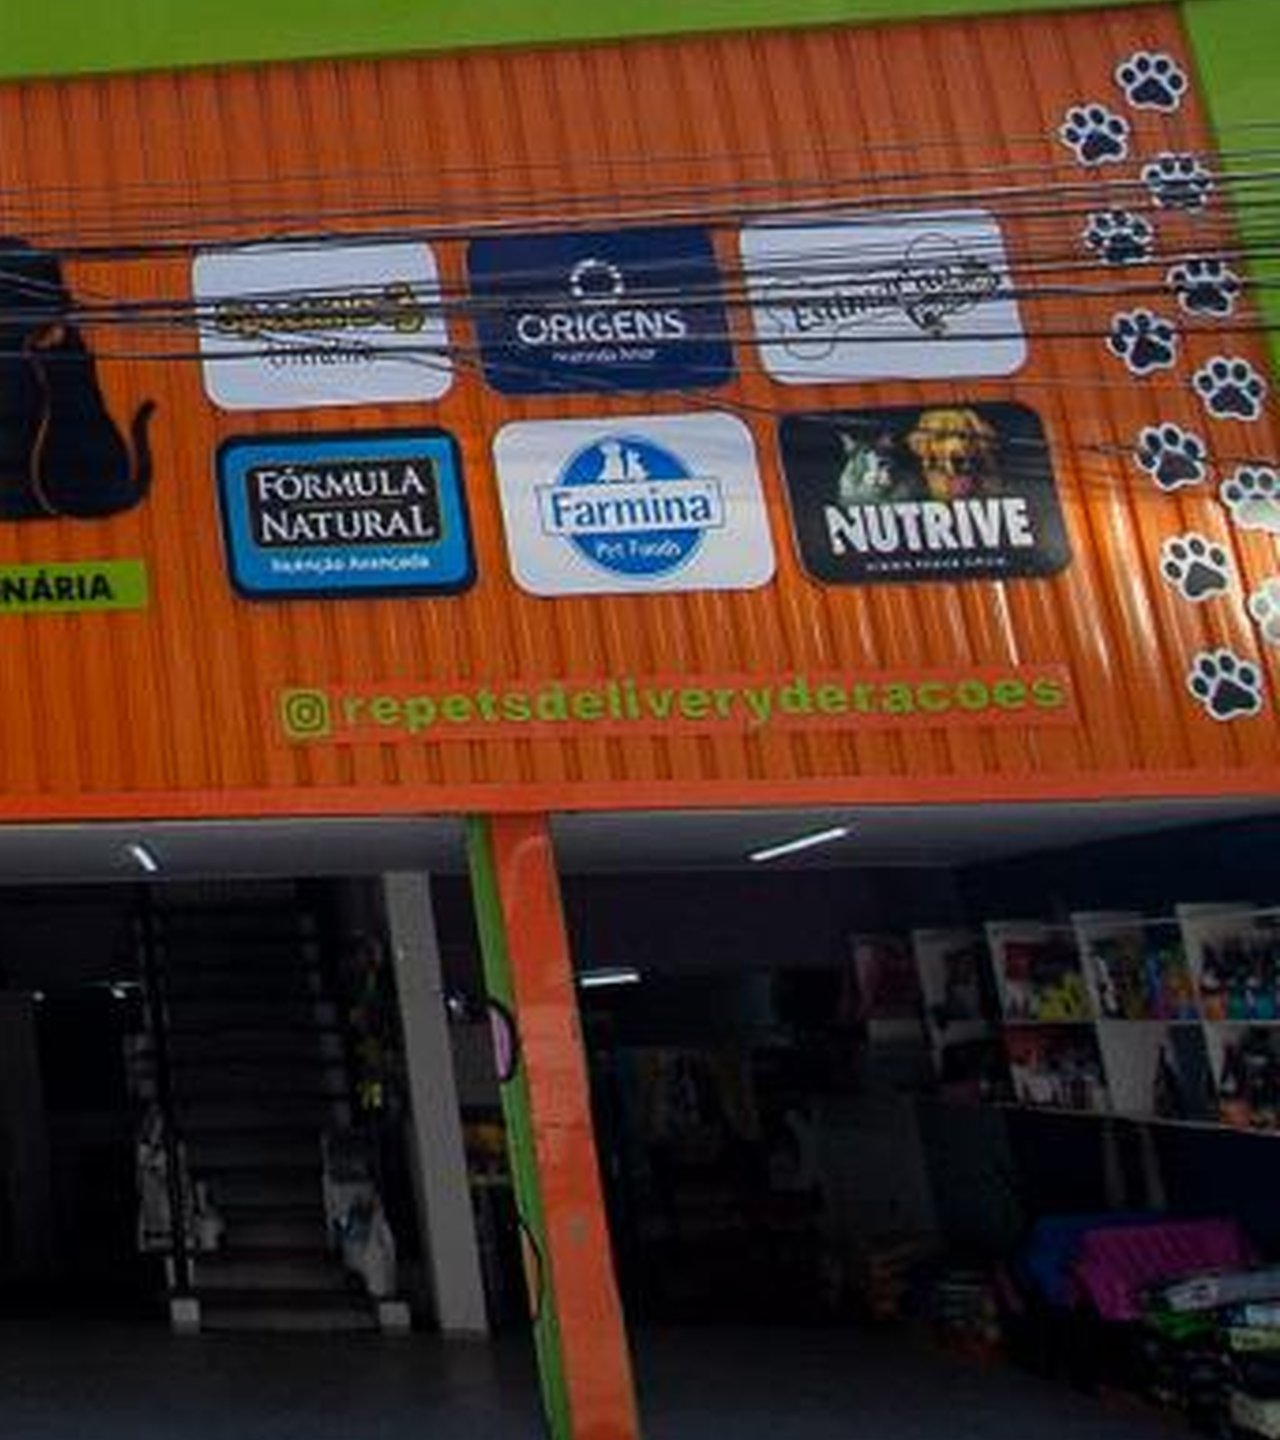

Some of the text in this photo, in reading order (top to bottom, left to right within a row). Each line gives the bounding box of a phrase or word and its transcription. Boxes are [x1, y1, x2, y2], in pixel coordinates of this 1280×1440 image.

[517, 310, 686, 344] ORIGENS
[256, 465, 428, 502] FÓRMULA
[260, 505, 435, 542] NATURAL
[551, 488, 712, 528] Farmina
[824, 497, 1035, 555] NUTRIVE
